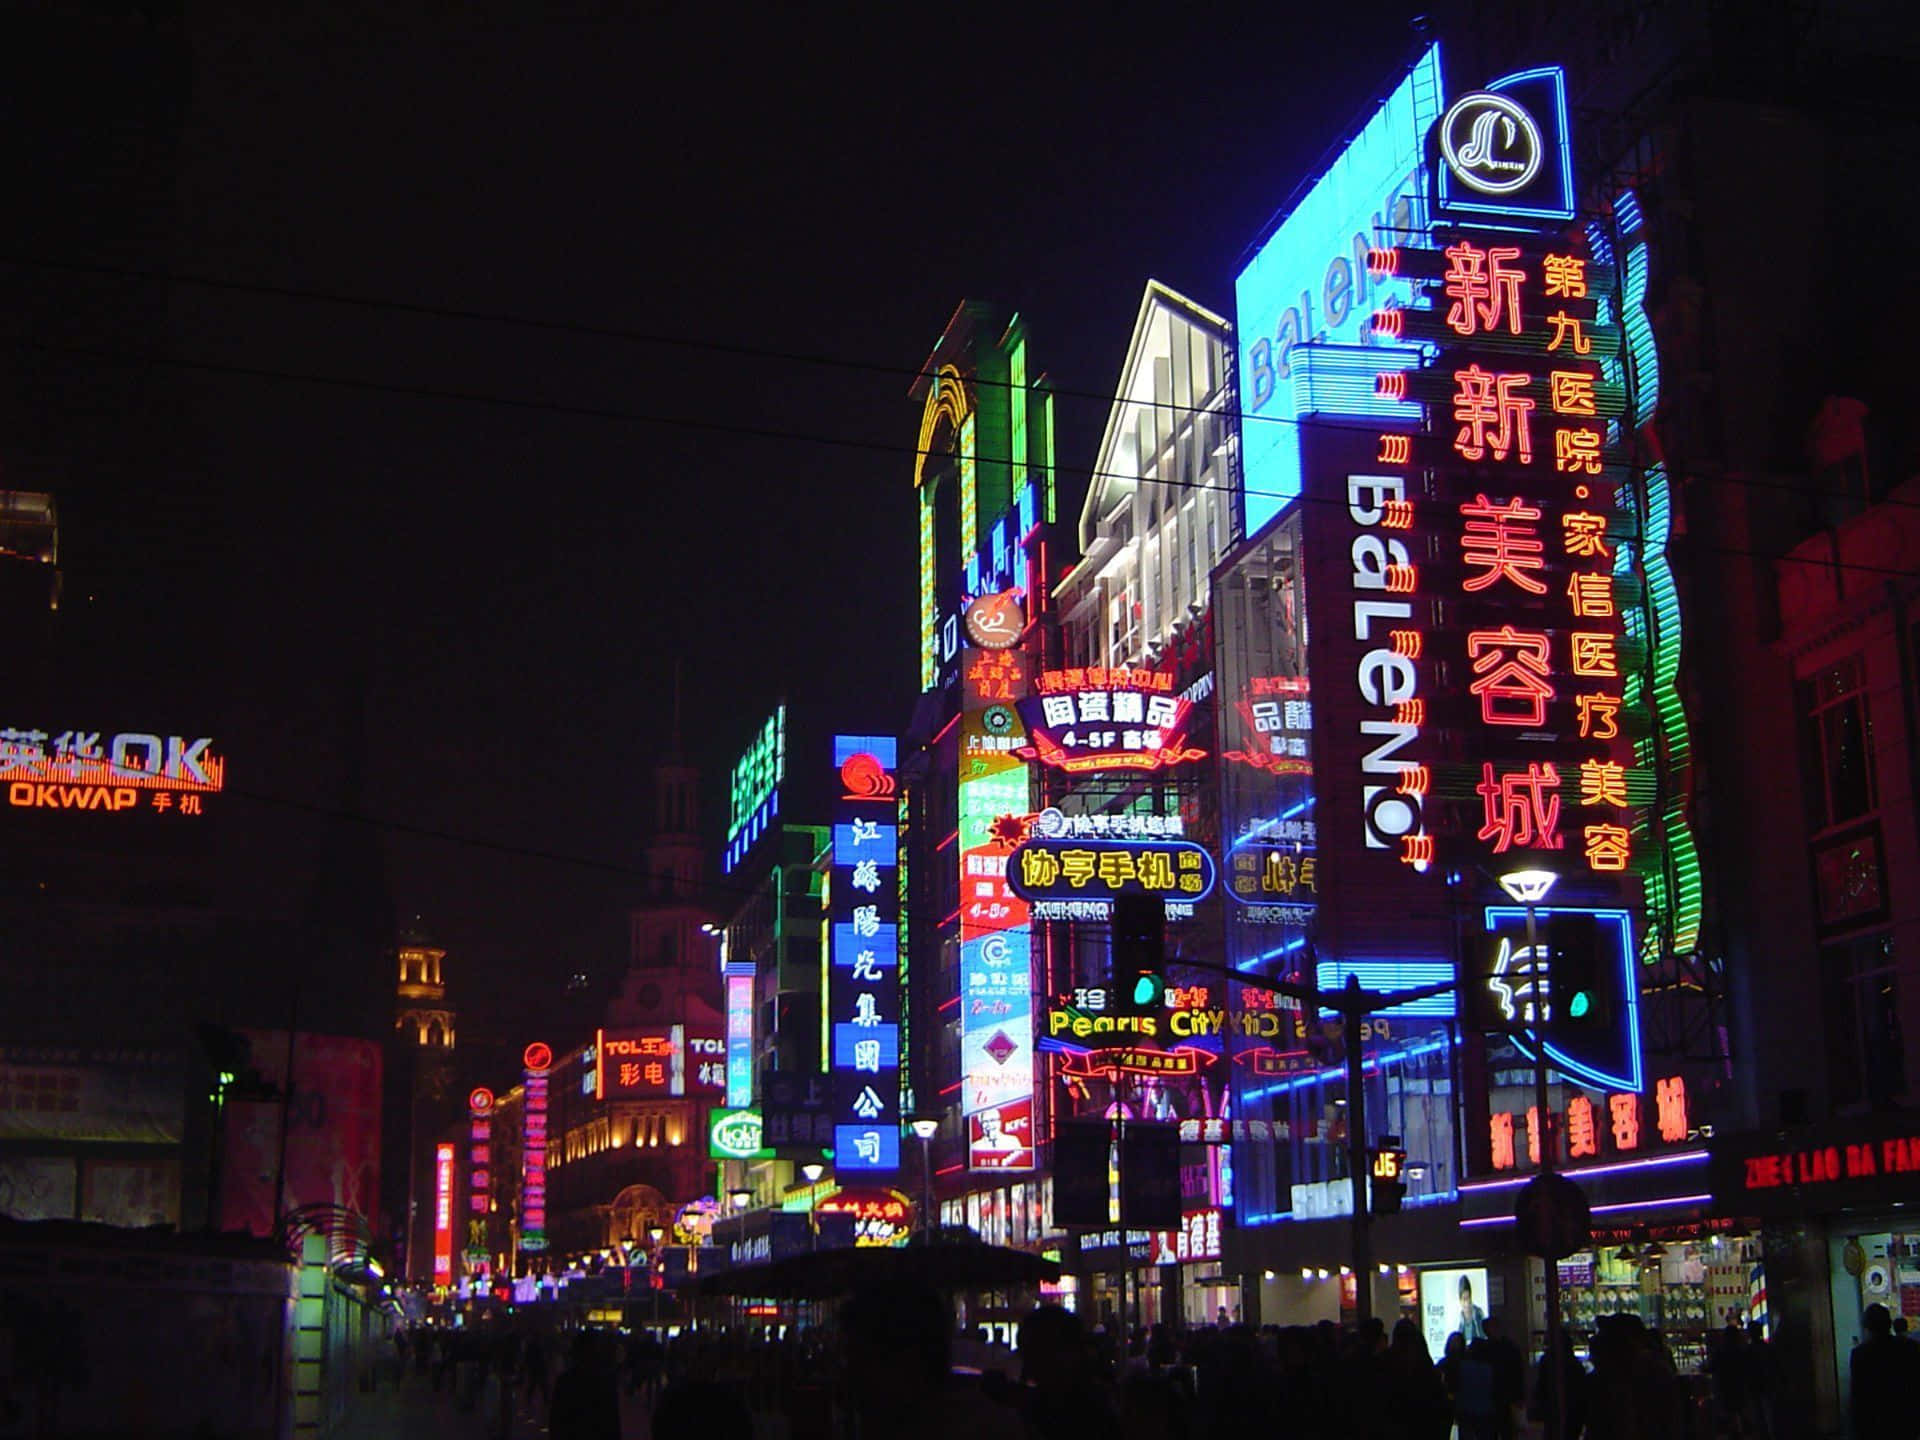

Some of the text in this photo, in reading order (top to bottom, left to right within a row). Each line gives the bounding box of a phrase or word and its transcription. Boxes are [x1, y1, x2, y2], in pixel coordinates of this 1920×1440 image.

[1446, 242, 1565, 853] 新新美容城
[9, 782, 203, 815] OKWAP 手机
[1022, 849, 1175, 890] 协亨手机
[1050, 1009, 1225, 1038] Pearls City
[690, 1039, 726, 1054] TCL
[620, 1062, 665, 1087] 彩电
[1004, 1115, 1030, 1133] KFC
